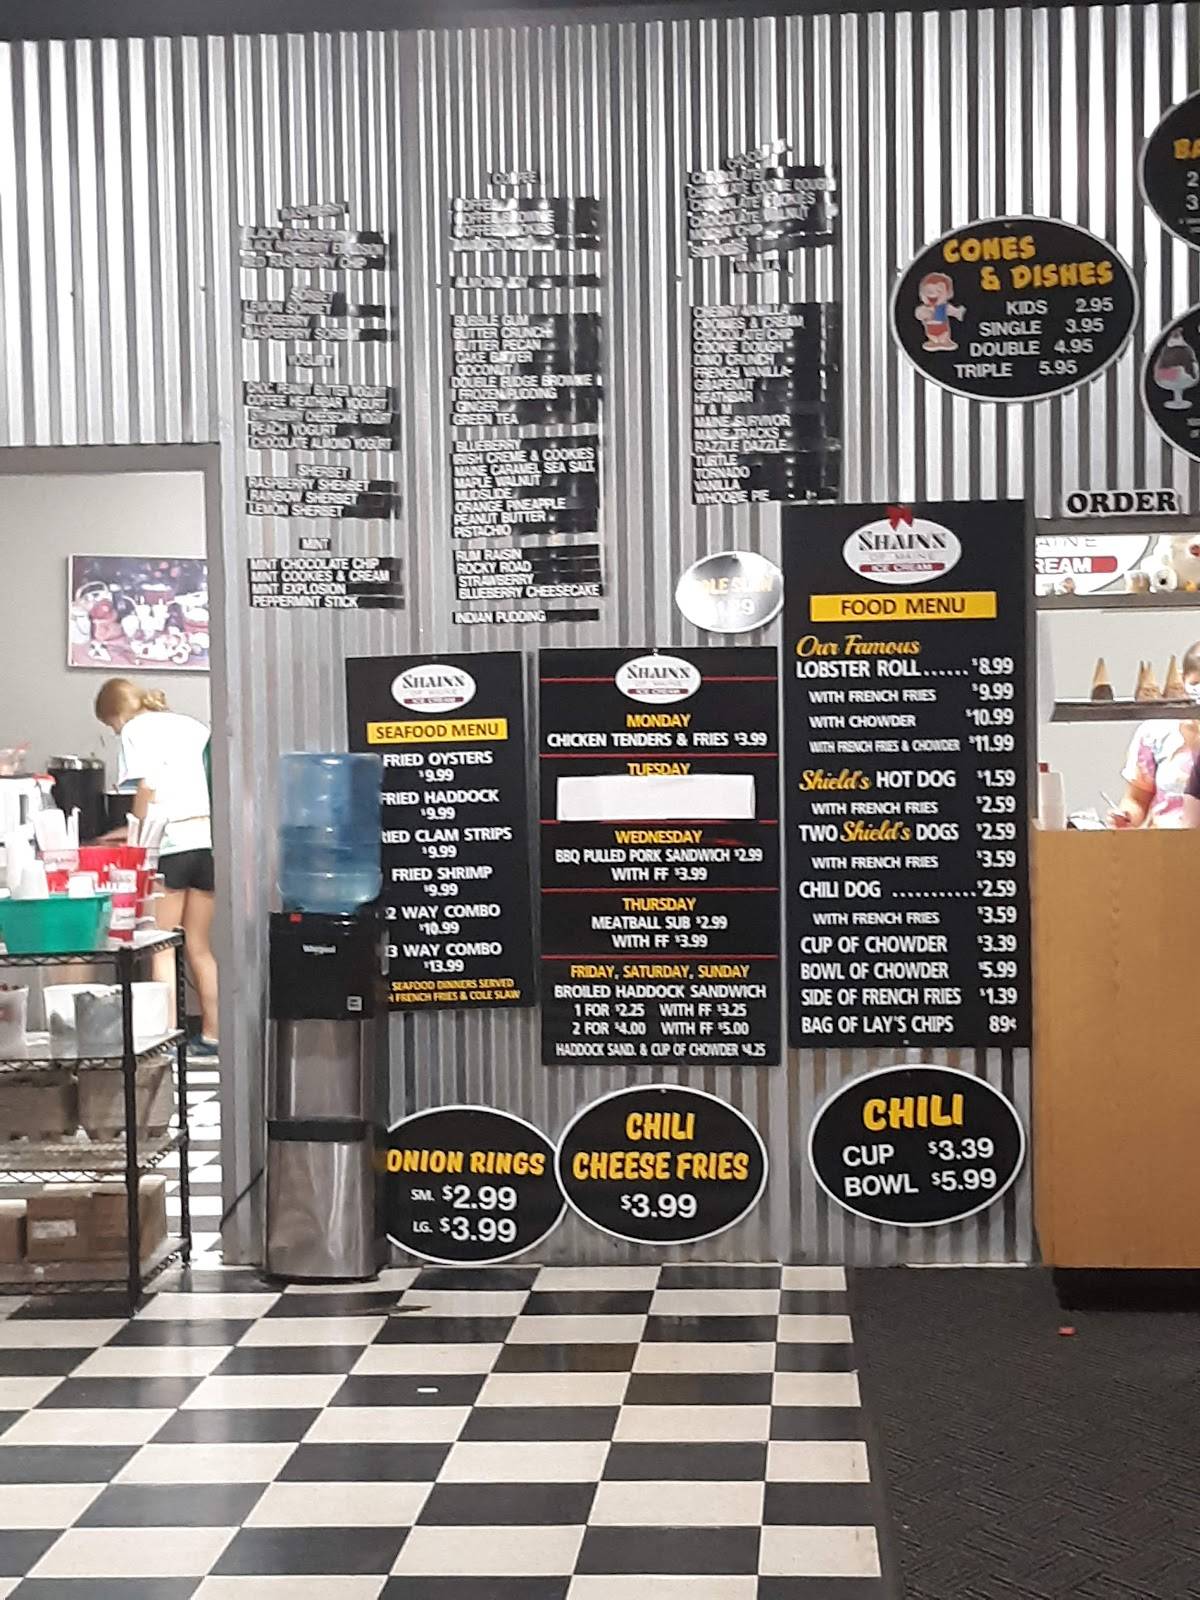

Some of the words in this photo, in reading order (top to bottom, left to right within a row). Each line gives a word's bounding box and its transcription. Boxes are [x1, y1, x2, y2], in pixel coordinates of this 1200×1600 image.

[943, 235, 1036, 263] CONES
[980, 266, 1001, 291] &
[1009, 261, 1113, 289] DISHES
[1006, 301, 1048, 315] KIDS
[1075, 298, 1113, 313] 2.95
[979, 321, 1042, 337] SINGLE
[1065, 318, 1104, 334] 3.95
[970, 340, 1040, 357] DOUBLE
[1054, 339, 1093, 354] 4.95
[954, 362, 1013, 378] TRIPLE
[1038, 360, 1077, 376] 5.95
[496, 414, 518, 424] TEA
[1068, 492, 1176, 513] ORDER
[501, 511, 545, 523] BUTTER
[303, 539, 328, 549] MINT
[251, 558, 277, 570] MINT
[281, 558, 349, 570] CHOCOLATE
[352, 558, 380, 569] CHIP
[251, 571, 278, 582] MINT
[282, 571, 332, 582] COOKIES
[349, 571, 390, 582] CREAM
[841, 600, 897, 615] FOOD
[906, 599, 965, 613] MENU
[796, 636, 839, 657] Our
[845, 634, 920, 655] Famous
[796, 661, 870, 678] LOBSTER
[972, 657, 1014, 675] $8.99
[808, 691, 845, 703] WITH
[849, 690, 898, 702] FRENCH
[903, 690, 936, 702] FRIES
[972, 683, 1014, 701] $9.99
[626, 714, 691, 727] MONDAY
[808, 716, 845, 728] WITH
[849, 715, 916, 728] CHOWDER
[965, 709, 1014, 726] $10.99
[377, 725, 447, 739] SEAFOOD
[452, 724, 499, 736] MENU
[547, 734, 607, 747] CHICKEN
[612, 733, 671, 746] TENDERS
[676, 733, 688, 746] &
[694, 733, 728, 746] FRIES
[383, 754, 423, 767] FRIED
[429, 751, 493, 765] OYSTERS
[419, 769, 454, 782] $9.99
[628, 763, 690, 775] TUESDAY
[799, 769, 870, 791] Shield's
[876, 771, 913, 788] HOT
[917, 770, 956, 788] DOG
[977, 770, 1015, 787] $1.59
[381, 792, 419, 805] FRIED
[425, 790, 499, 803] HADDOCK
[811, 803, 847, 814] WITH
[850, 802, 900, 814] FRENCH
[905, 802, 938, 814] FRIES
[976, 796, 1016, 813] $2.59
[421, 807, 455, 820] $9.99
[415, 830, 459, 842] CLAM
[464, 828, 512, 841] STRIPS
[615, 831, 702, 844] WEDNESDAY
[799, 825, 838, 841] TWO
[841, 820, 911, 842] Shield's
[916, 824, 959, 840] DOGS
[976, 823, 1016, 840] $2.59
[422, 845, 457, 858] $9.99
[555, 850, 580, 864] BBQ
[584, 849, 626, 862] PULLED
[630, 849, 661, 862] PORK
[666, 849, 730, 862] SANDWICH
[392, 868, 432, 881] FRIED
[437, 866, 492, 880] SHRIMP
[611, 868, 649, 881] WITH
[654, 868, 669, 880] FF
[674, 868, 707, 880] $3.99
[424, 883, 458, 896] $9.99
[800, 881, 838, 898] CHILI
[845, 881, 881, 897] DOG
[977, 880, 1016, 897] $2.59
[401, 906, 438, 919] WAY
[444, 904, 500, 917] COMBO
[622, 898, 696, 911] THURSDAY
[592, 916, 660, 929] MEATBALL
[665, 916, 690, 929] SUB
[696, 916, 727, 929] $2.99
[403, 944, 440, 957] WAY
[446, 942, 501, 955] COMBO
[801, 937, 832, 953] CUP
[837, 937, 859, 953] OF
[865, 936, 947, 952] CHOWDER
[977, 935, 1017, 951] $3.39
[571, 966, 619, 979] FRIDAY,
[623, 965, 694, 979] SATURDAY,
[699, 965, 749, 978] SUNDAY
[554, 986, 611, 999] BROILED
[616, 985, 684, 998] HADDOCK
[690, 985, 766, 998] SANDWICH
[801, 989, 832, 1006] SIDE
[837, 989, 858, 1005] OF
[862, 988, 918, 1005] FRENCH
[924, 988, 961, 1005] FRIES
[980, 988, 1017, 1005] $1.39
[575, 1004, 580, 1017] 1
[585, 1004, 609, 1017] FOR
[660, 1003, 694, 1016] WITH
[699, 1003, 712, 1016] FF
[802, 1016, 833, 1033] BAG
[838, 1016, 858, 1033] OF
[863, 1016, 906, 1033] LAY'S
[911, 1016, 953, 1032] CHIPS
[863, 1094, 964, 1131] CHILI
[626, 1113, 695, 1141] CHILI
[843, 1144, 894, 1166] CUP
[928, 1137, 994, 1160] $3.39
[386, 1150, 462, 1174] ONION
[469, 1152, 545, 1175] RINGS
[573, 1153, 670, 1181] CHEESE
[677, 1153, 749, 1181] FRIES
[844, 1173, 919, 1197] BOWL
[931, 1168, 997, 1191] $5.99
[410, 1189, 435, 1201] SM.
[442, 1185, 517, 1211] $2.99
[620, 1193, 697, 1218] $3.99
[440, 1216, 517, 1242] $3.99
